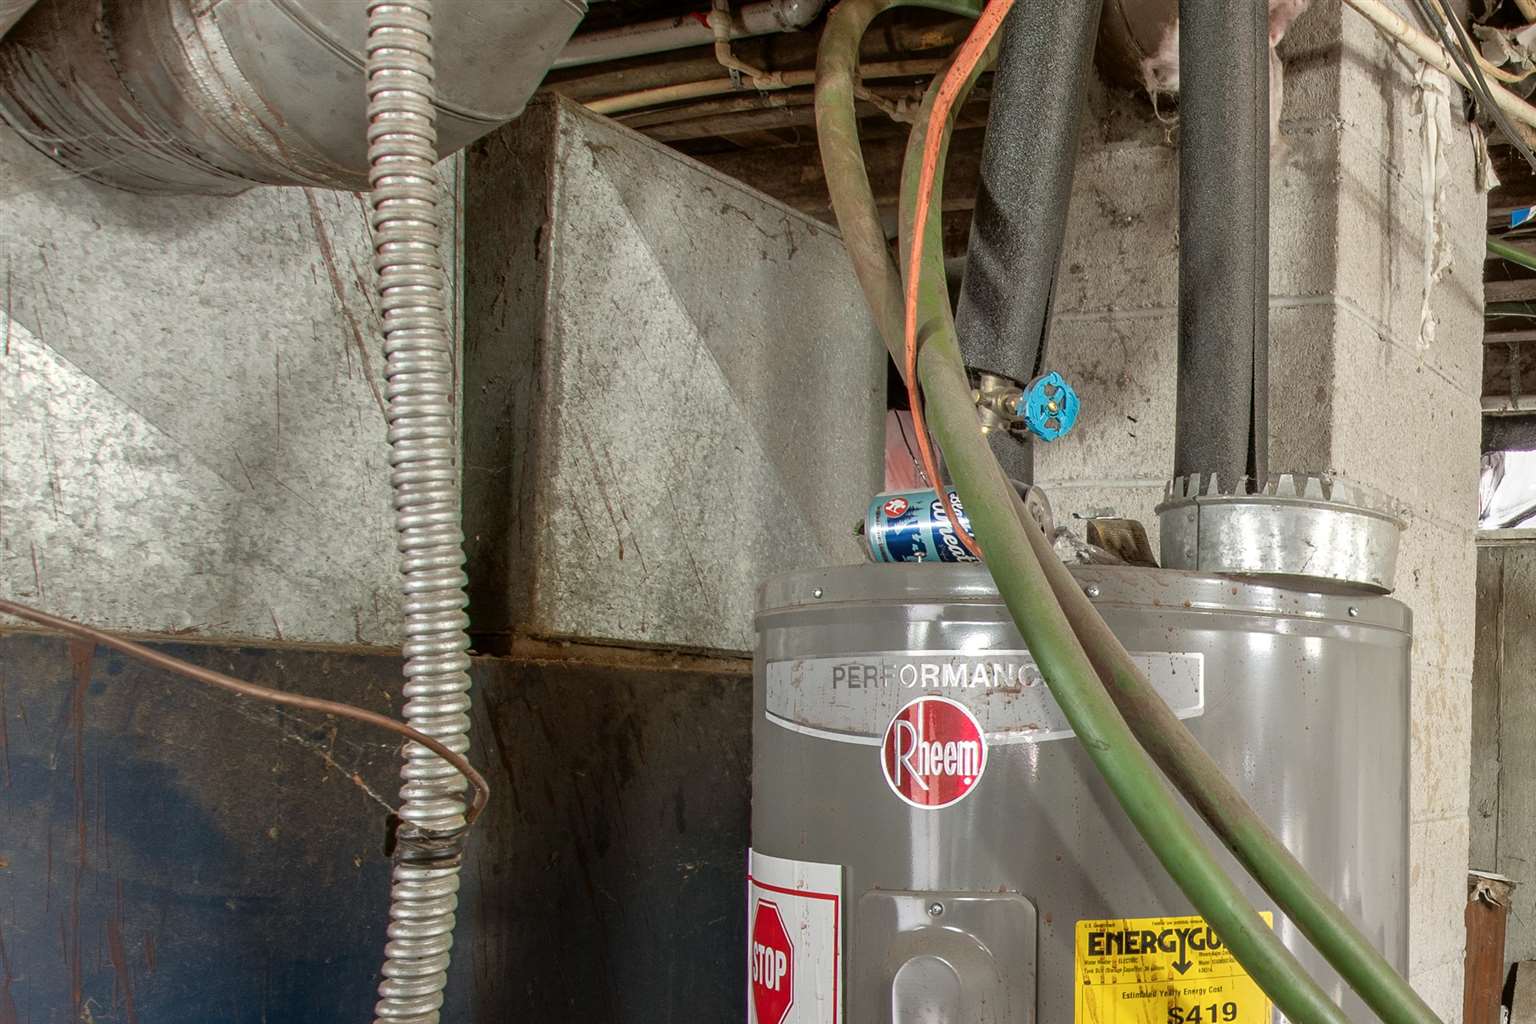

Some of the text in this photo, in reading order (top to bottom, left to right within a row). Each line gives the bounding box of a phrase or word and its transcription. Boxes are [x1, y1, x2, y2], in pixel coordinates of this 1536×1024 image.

[832, 663, 1048, 689] PERFORMANC
[895, 701, 979, 791] Rheem
[1088, 927, 1225, 957] ENERGYGU
[753, 941, 787, 992] STOP
[1122, 989, 1157, 1000] Estimated
[1159, 987, 1181, 998] Yearly
[1183, 987, 1207, 997] Energy
